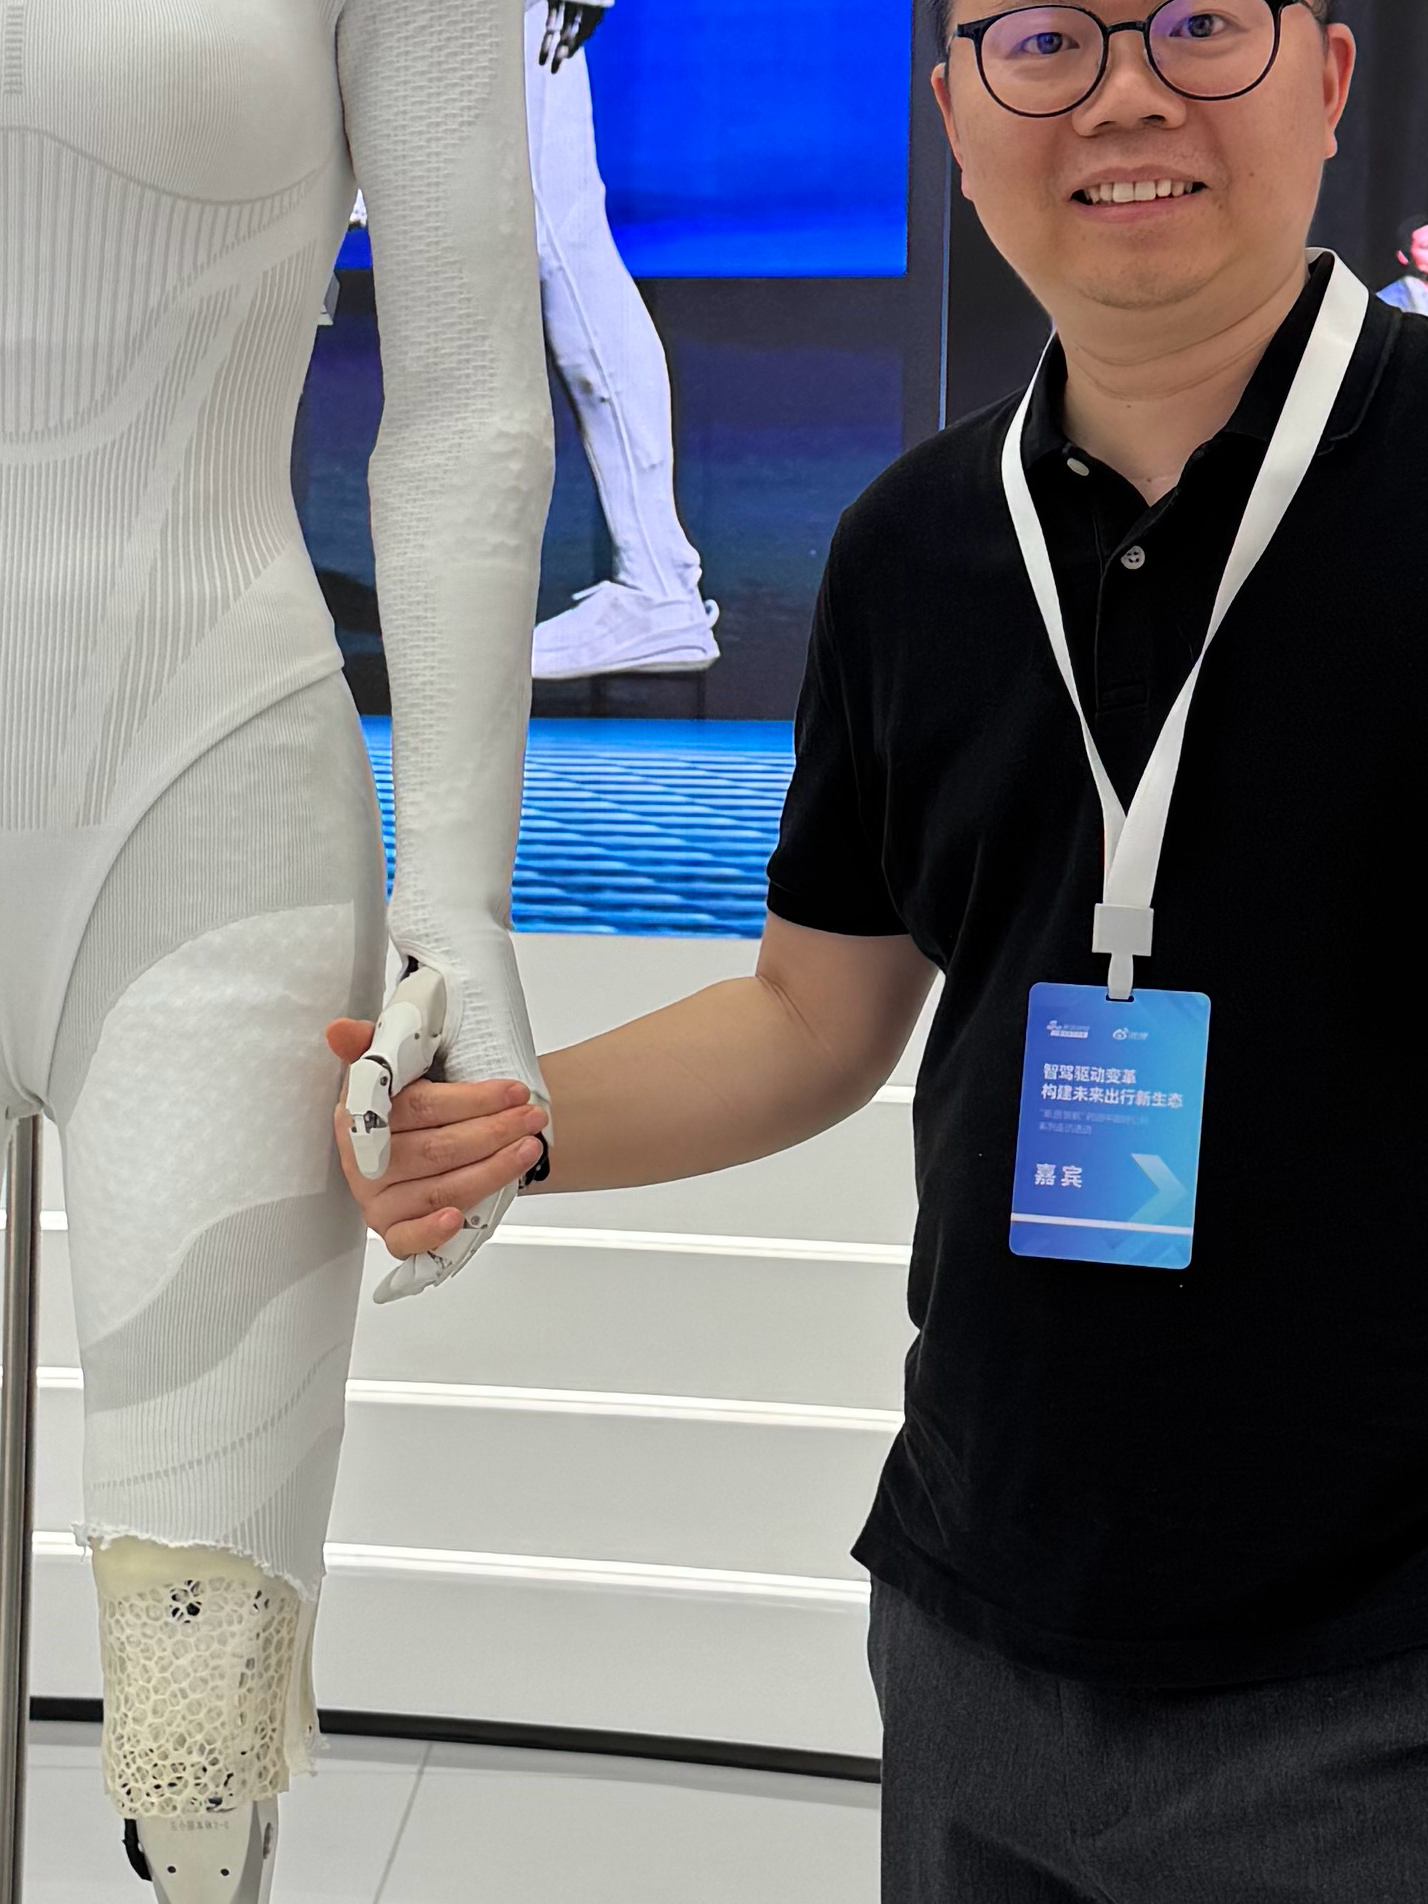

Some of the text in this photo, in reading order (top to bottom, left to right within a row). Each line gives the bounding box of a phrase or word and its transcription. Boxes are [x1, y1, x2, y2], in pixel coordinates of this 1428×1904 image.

[1043, 1063, 1137, 1085] 智驾驱动变革
[1041, 1083, 1183, 1109] 构建未来出行新生态
